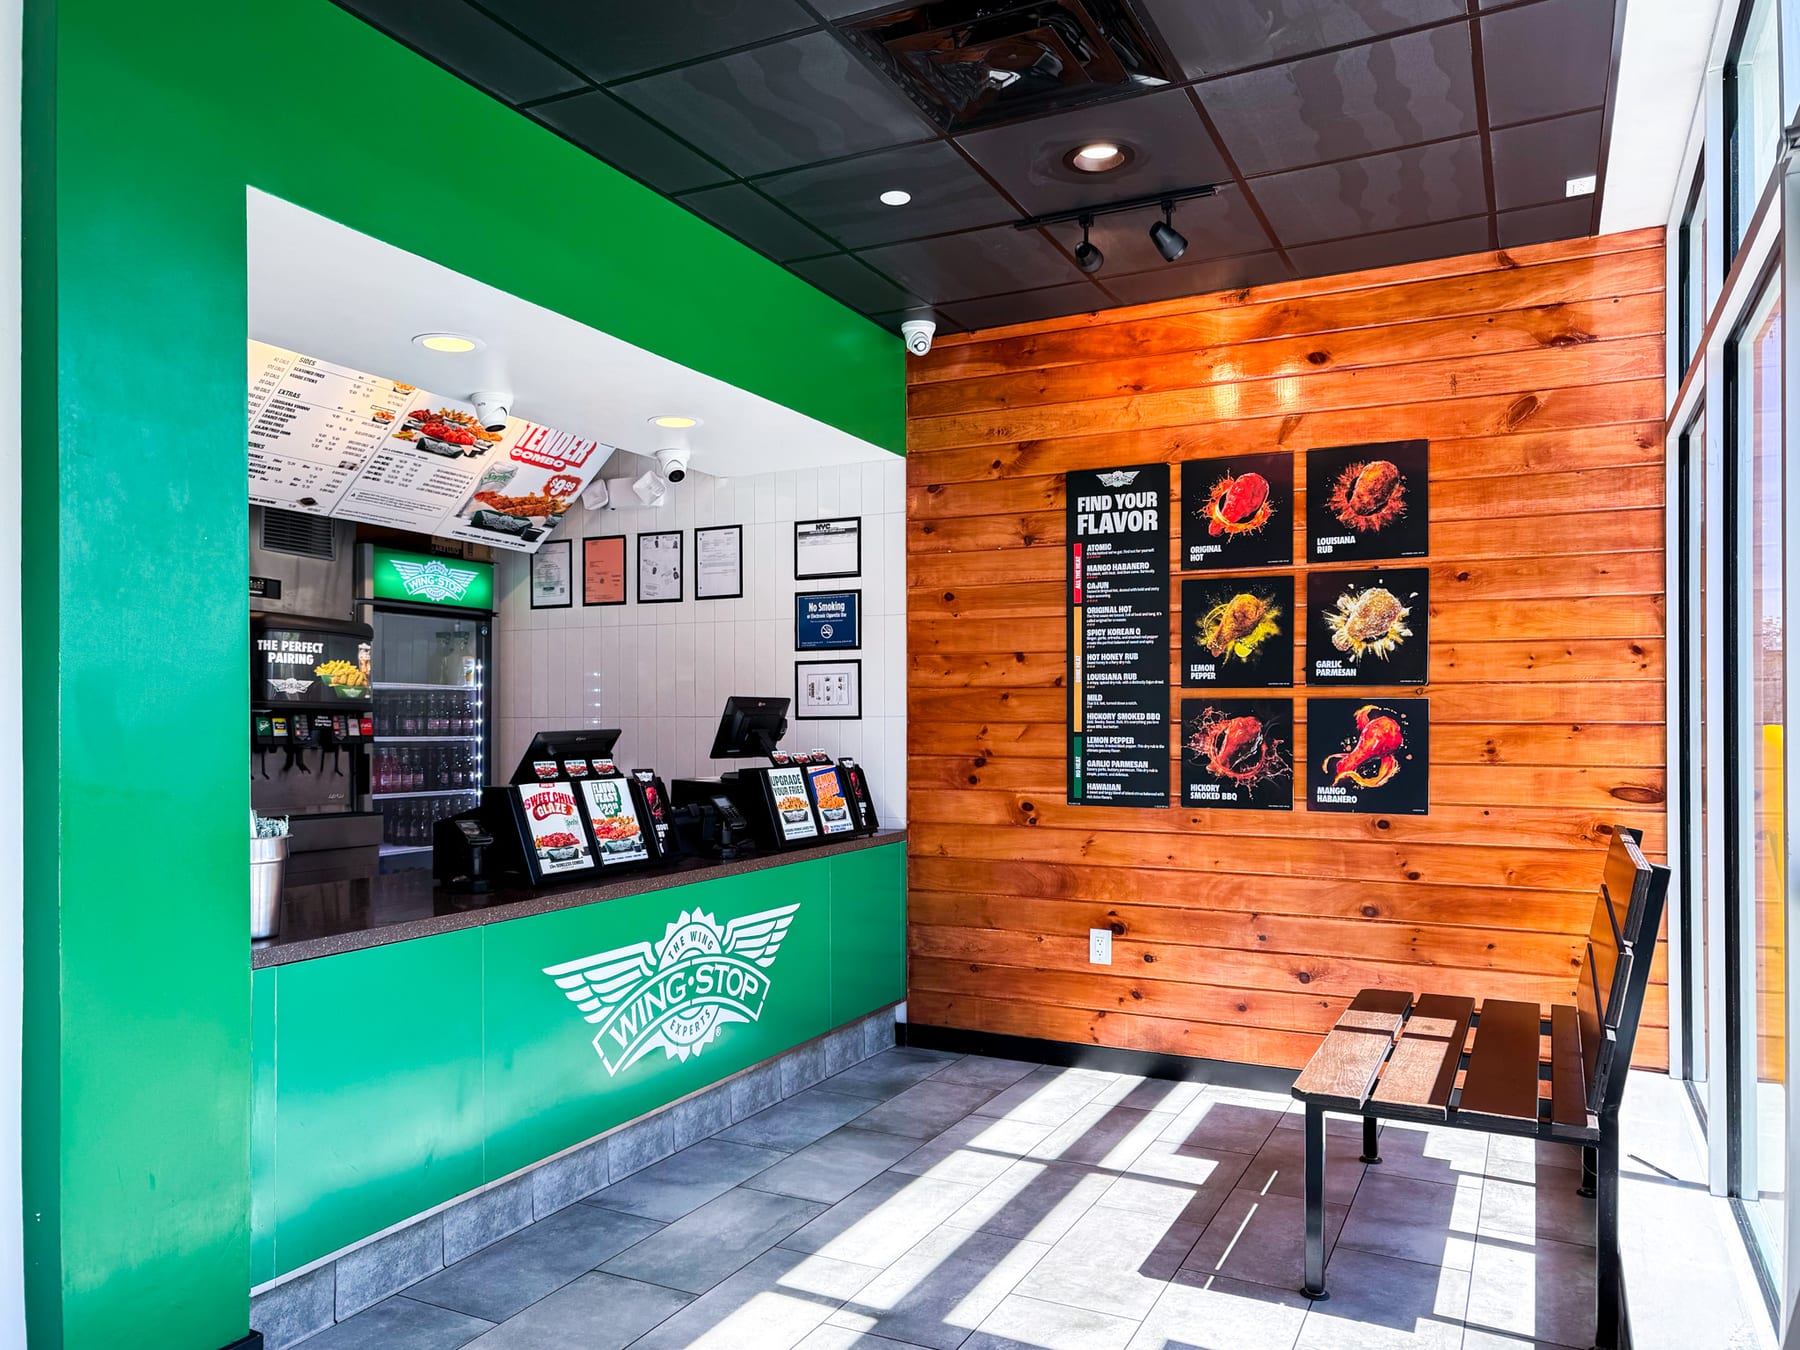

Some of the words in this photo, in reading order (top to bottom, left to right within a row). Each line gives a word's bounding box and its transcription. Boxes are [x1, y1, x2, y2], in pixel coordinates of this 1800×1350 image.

[299, 357, 317, 366] SIDES
[277, 388, 301, 399] EXTRAS
[515, 423, 595, 464] TENDER
[511, 448, 565, 468] COMBO
[1077, 495, 1112, 513] FIND
[1114, 491, 1158, 510] YOUR
[1077, 509, 1158, 536] FLAVOR
[1316, 535, 1356, 545] LOUISIANA
[1086, 543, 1112, 552] ATOMIC
[1190, 544, 1222, 554] ORIGINAL
[1316, 545, 1333, 554] RUB
[1190, 553, 1204, 562] HOT
[1086, 563, 1112, 572] MANGO
[1112, 561, 1150, 571] HABANERO
[1086, 581, 1110, 590] CAJUN
[808, 602, 818, 612] No
[818, 601, 845, 612] Smoking
[1086, 606, 1118, 614] ORIGINAL
[1118, 605, 1132, 613] HOT
[1086, 628, 1106, 636] SPICY
[1107, 627, 1135, 636] KOREAN
[1135, 627, 1141, 635] Q
[257, 639, 278, 651] THE
[281, 640, 324, 654] PERFECT
[268, 652, 314, 665] PAIRING
[1086, 653, 1100, 661] HOT
[1100, 653, 1124, 661] HONEY
[1124, 652, 1139, 660] RUB
[1190, 663, 1215, 672] LEMON
[1315, 660, 1342, 668] GARLIC
[1086, 672, 1123, 680] LOUISIANA
[1123, 672, 1138, 680] RUB
[1190, 672, 1216, 680] PEPPER
[1315, 668, 1357, 676] PARMESAN
[1086, 693, 1103, 701] MILD
[1086, 712, 1117, 720] HICKORY
[1117, 712, 1145, 720] SMOKED
[1146, 712, 1161, 721] BBQ
[1086, 736, 1109, 744] LEMON
[1109, 736, 1135, 745] PEPPER
[1086, 759, 1111, 767] GARLIC
[1111, 760, 1149, 768] PARMESAN
[770, 774, 802, 787] UPGRADE
[772, 786, 789, 797] YOUR
[788, 785, 804, 795] FRIES
[1086, 782, 1122, 791] HAWAIIAN
[1190, 783, 1220, 792] HICKORY
[1317, 786, 1346, 795] MANGO
[524, 791, 551, 810] SWEET
[595, 792, 618, 803] FEAST
[1190, 791, 1220, 800] SMOKED
[1221, 792, 1238, 801] BBQ
[1317, 794, 1358, 804] HABANERO
[537, 801, 567, 816] GLAZE
[667, 935, 686, 961] THE
[690, 930, 714, 951] WING
[669, 1008, 712, 1037] EXPERTS
